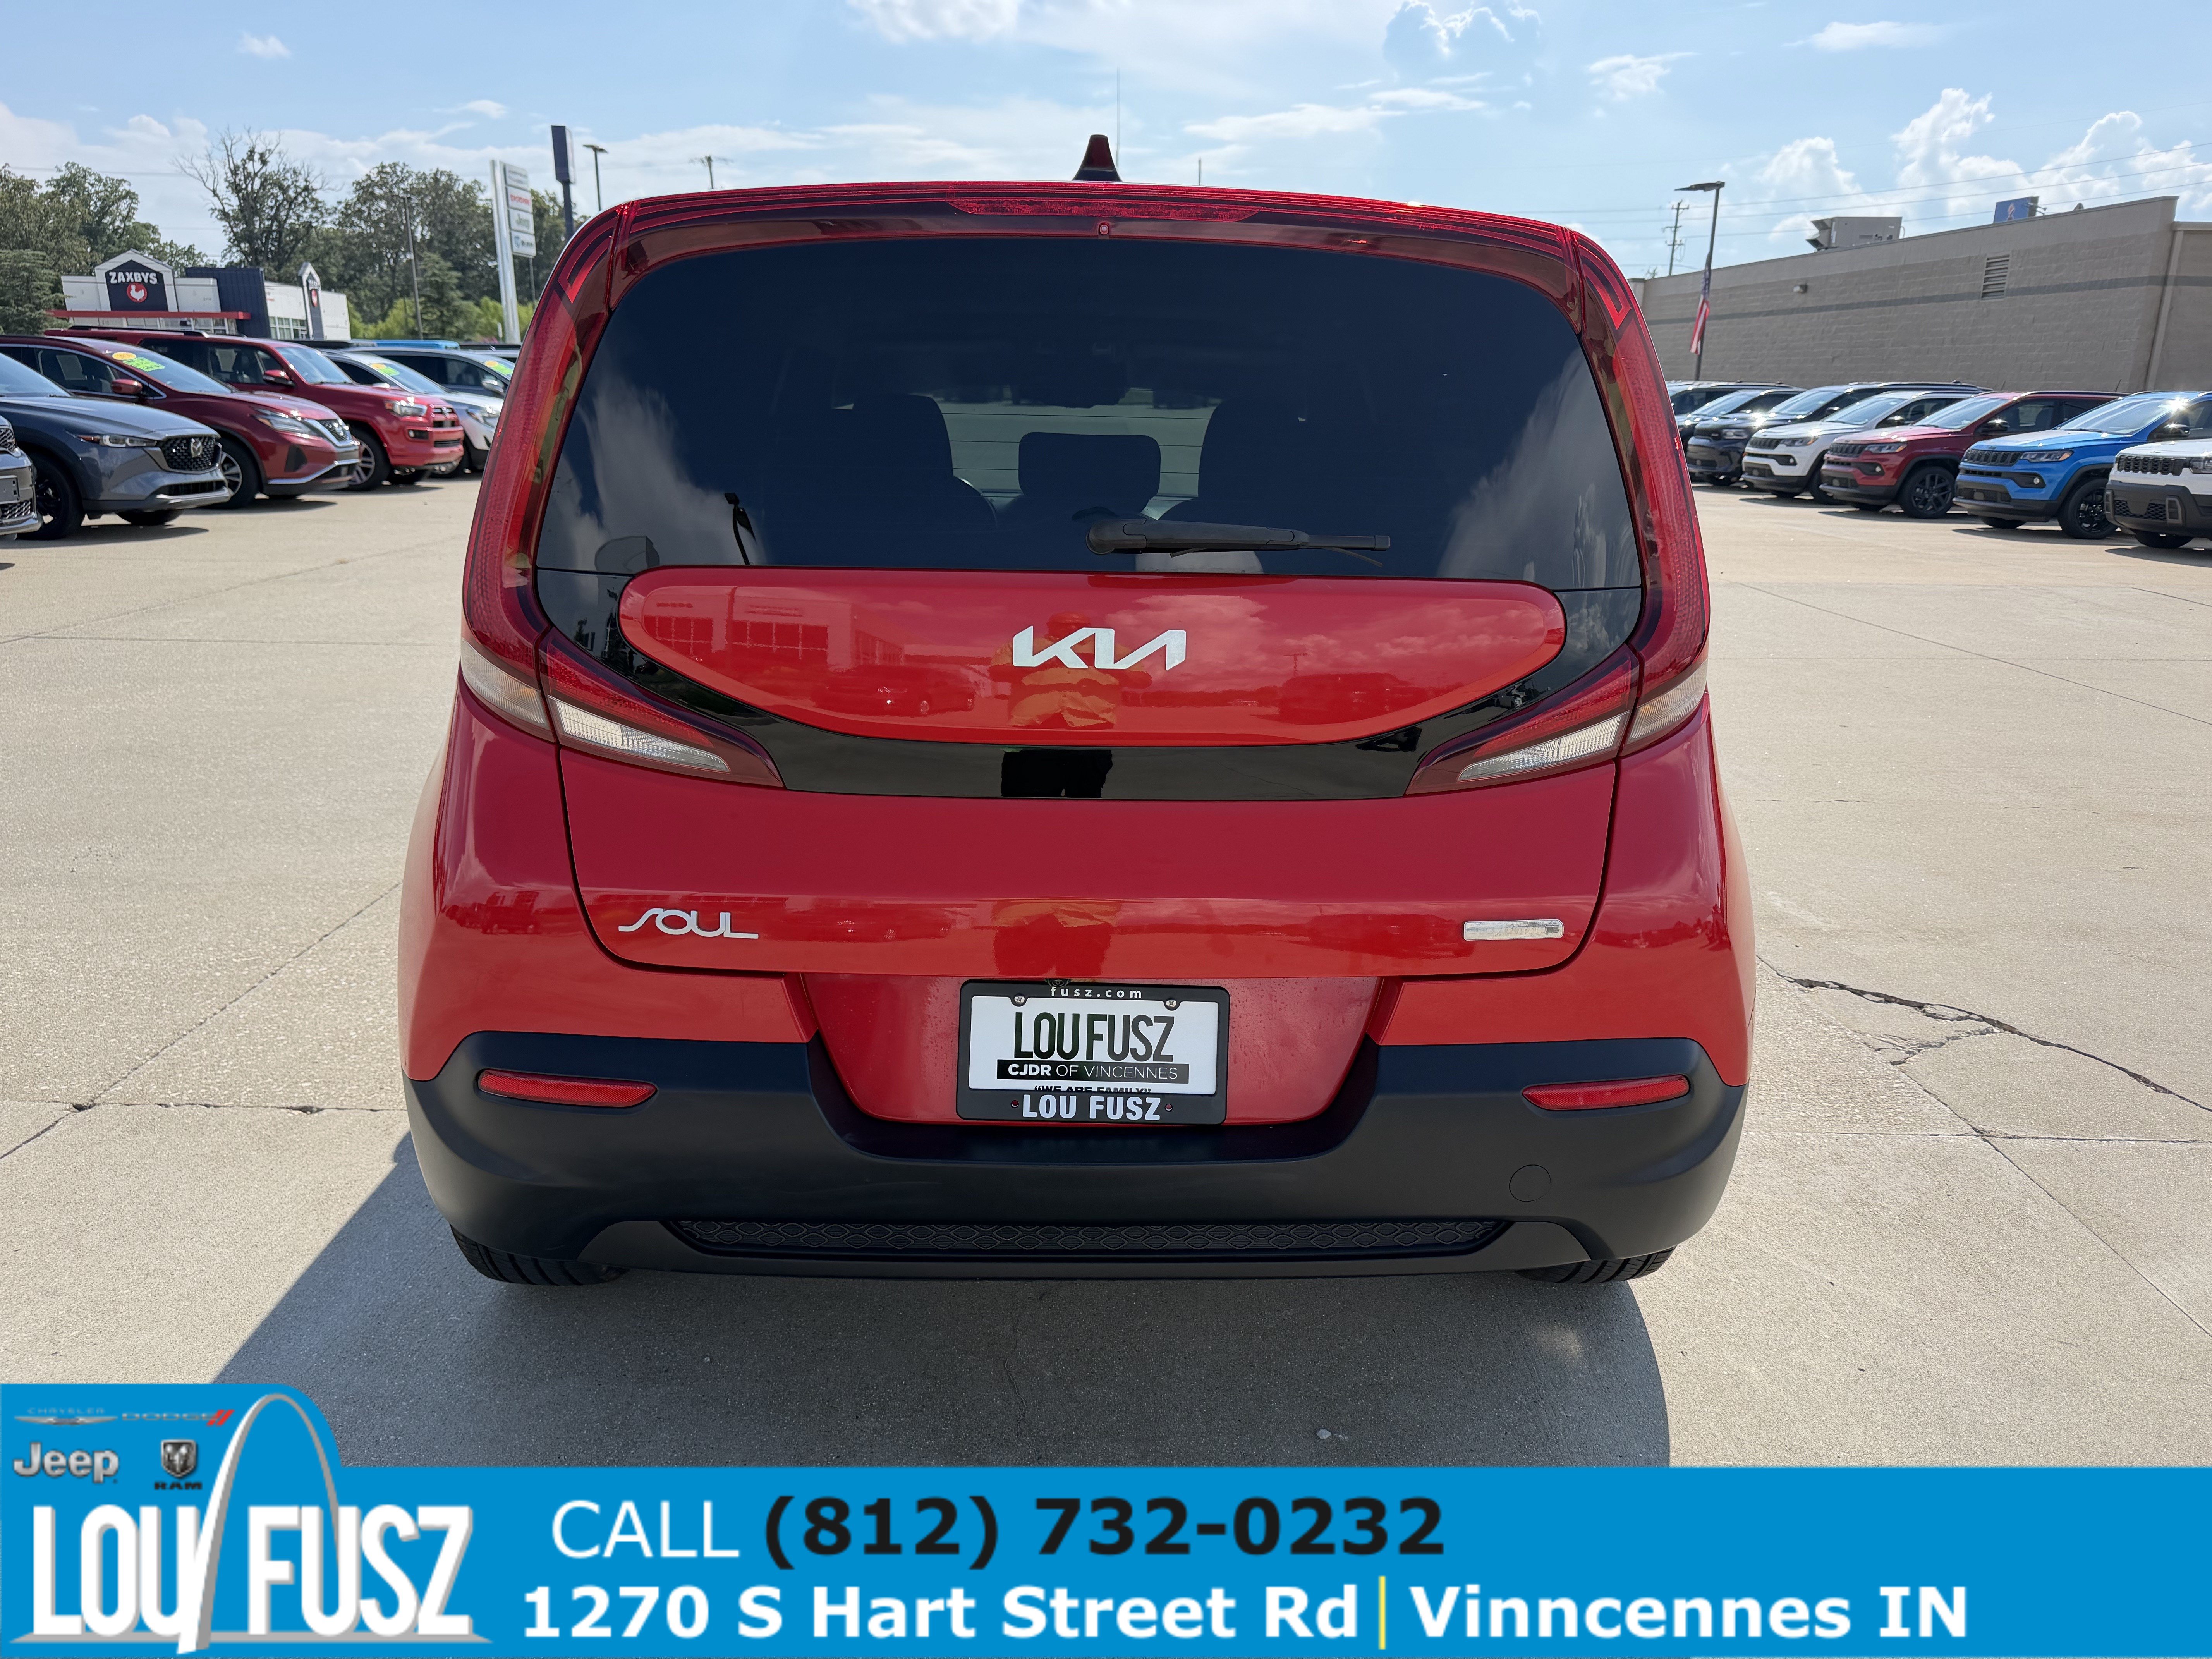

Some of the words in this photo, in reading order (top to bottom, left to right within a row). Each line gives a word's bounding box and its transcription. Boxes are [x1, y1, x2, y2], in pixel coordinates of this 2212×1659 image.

[109, 272, 158, 284] ZAXBYS
[1013, 626, 1187, 670] KIA
[618, 908, 759, 939] SOUL
[1050, 986, 1142, 998] fusz.com
[1014, 1012, 1080, 1060] LOU
[1086, 1013, 1175, 1062] FUSZ
[1008, 1063, 1051, 1076] CJDR
[1056, 1065, 1078, 1077] OF
[1084, 1065, 1178, 1079] VINCENNES
[1023, 1094, 1077, 1118] LOU
[1089, 1096, 1161, 1120] FUSZ
